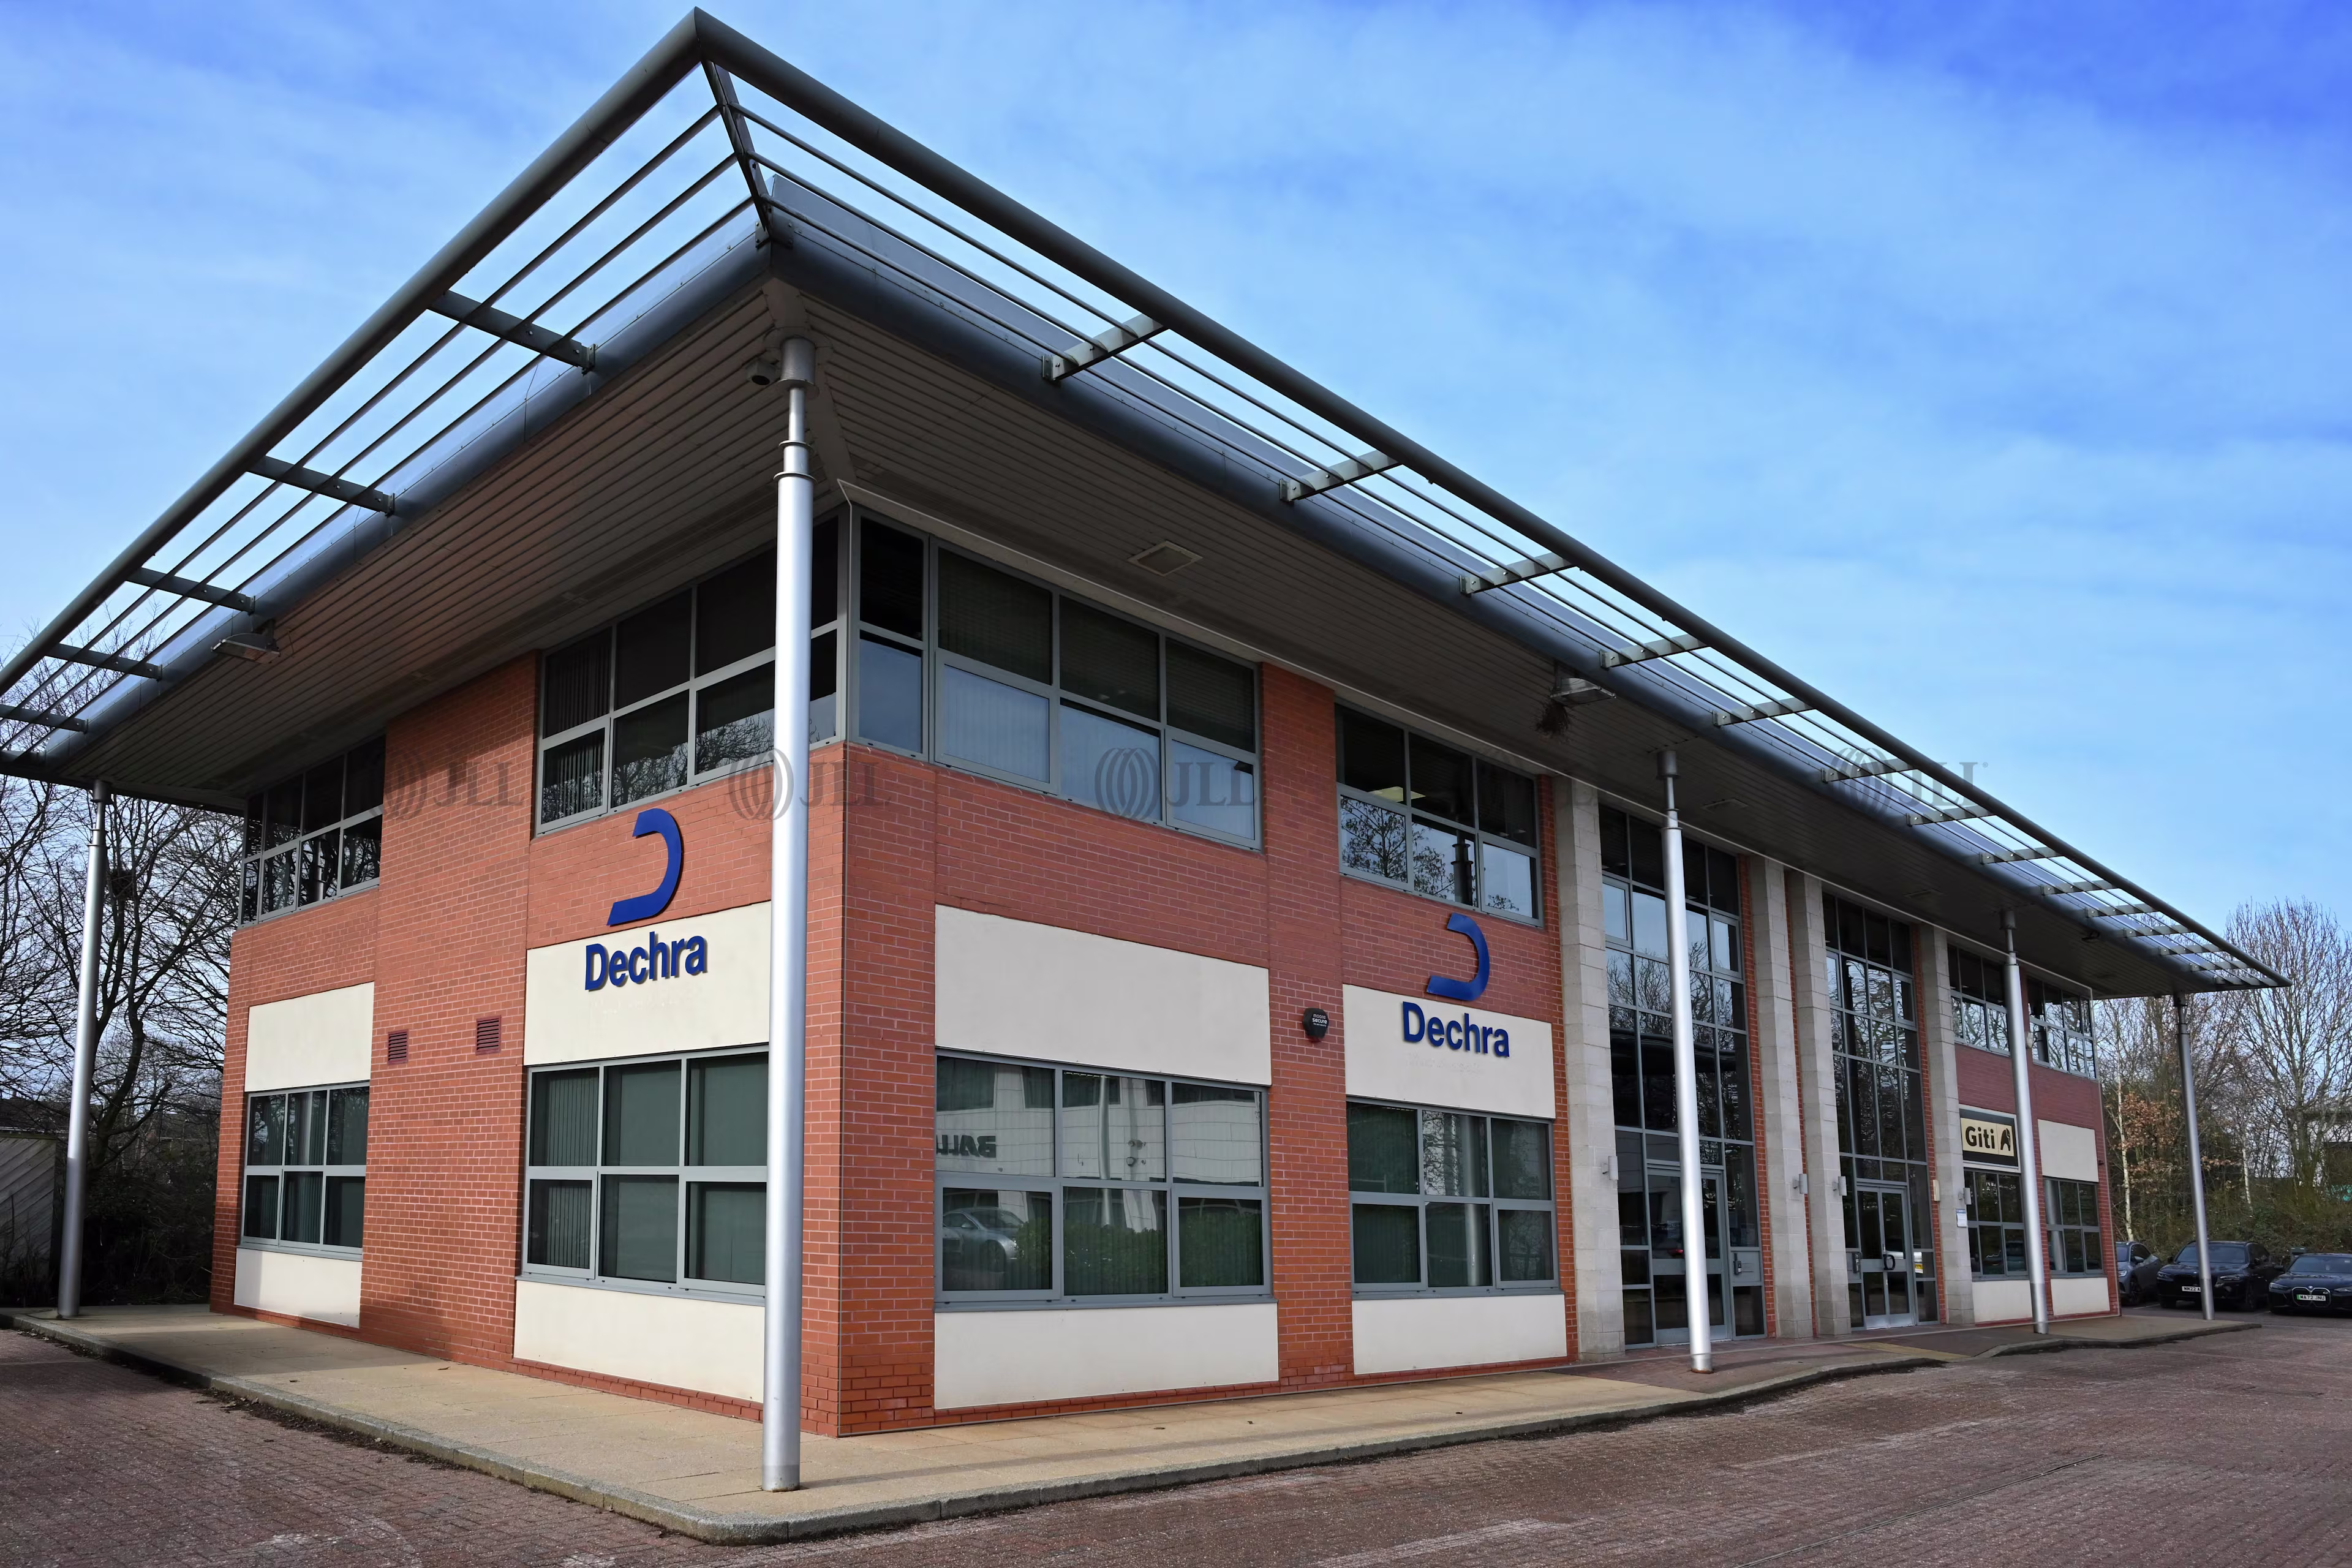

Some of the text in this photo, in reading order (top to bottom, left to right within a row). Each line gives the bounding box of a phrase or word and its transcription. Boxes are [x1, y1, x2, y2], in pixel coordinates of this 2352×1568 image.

[585, 931, 706, 990] Dechra
[1402, 1001, 1510, 1057] Dechra
[1965, 1126, 1996, 1149] Giti
